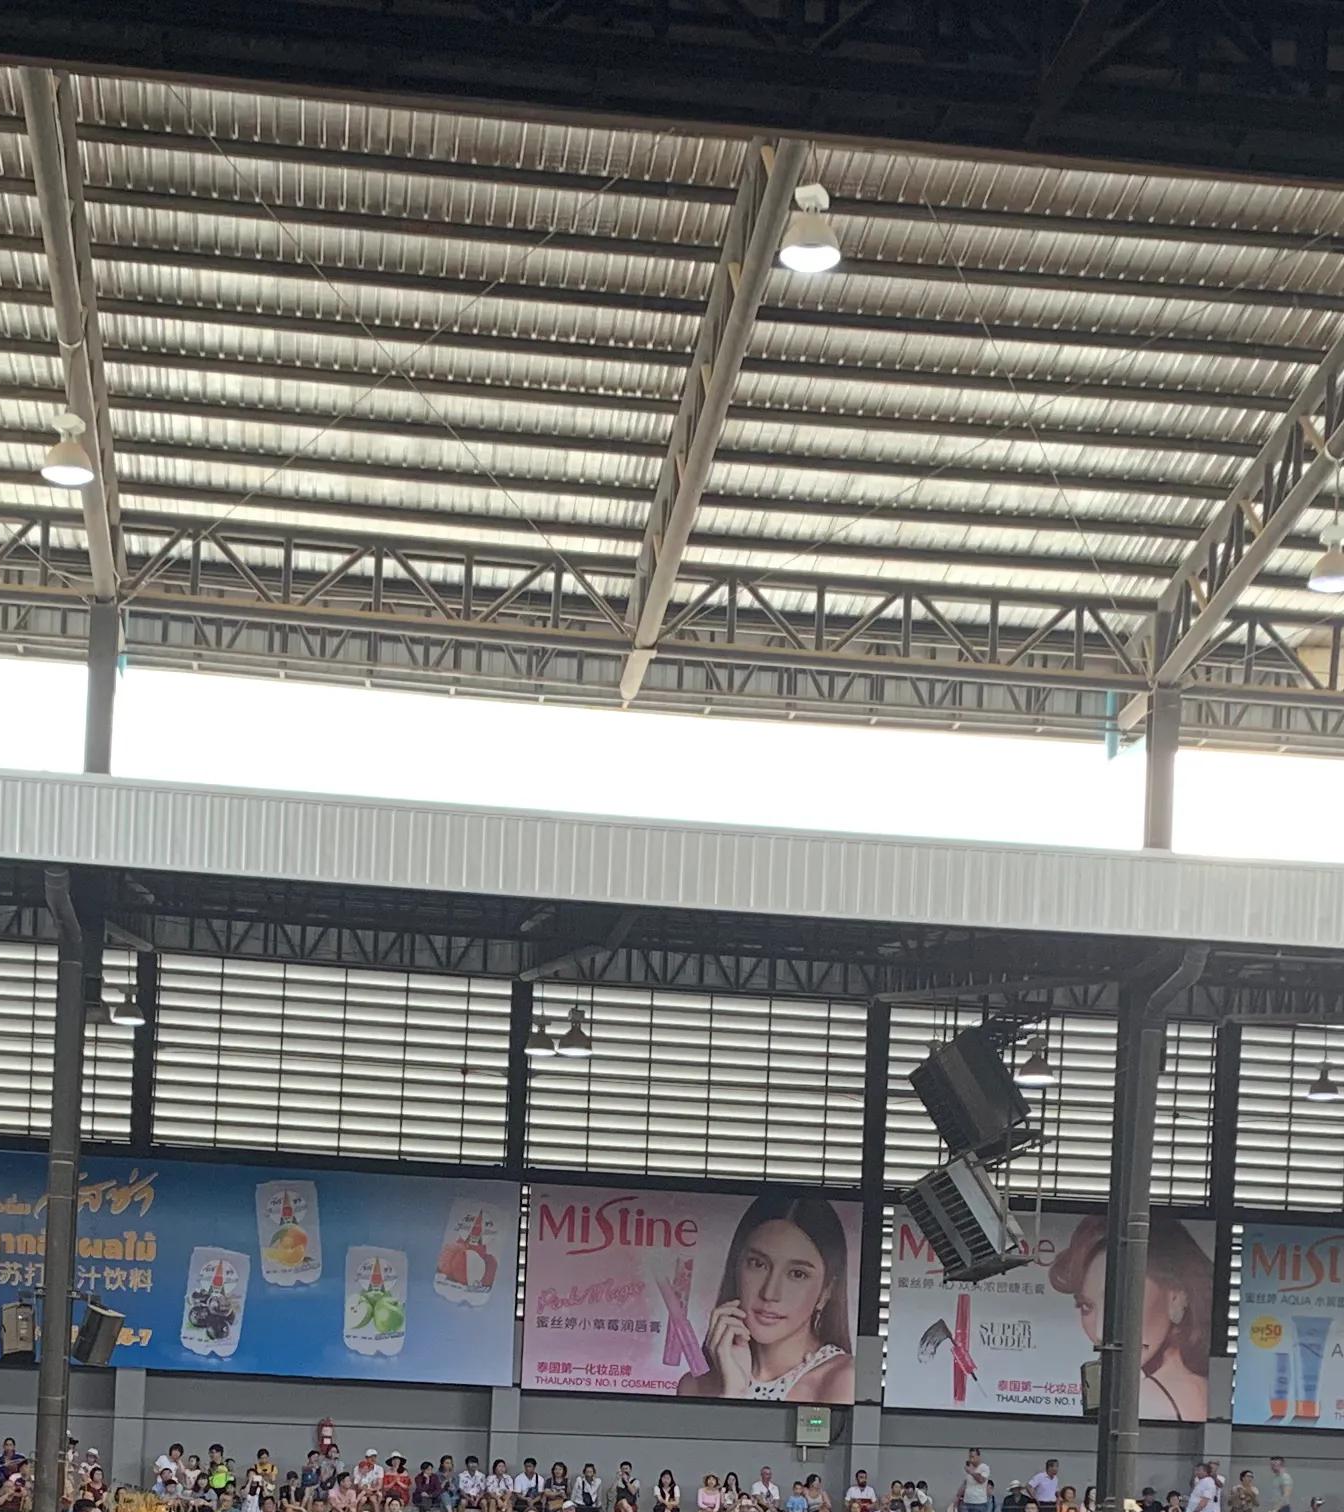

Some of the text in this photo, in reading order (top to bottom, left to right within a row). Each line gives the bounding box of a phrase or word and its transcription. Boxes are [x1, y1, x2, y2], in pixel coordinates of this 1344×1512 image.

[621, 1379, 679, 1391] COSMETICS
[997, 1379, 1084, 1395] 泰国第一化妆品
[996, 1394, 1052, 1405] THAILAND'S
